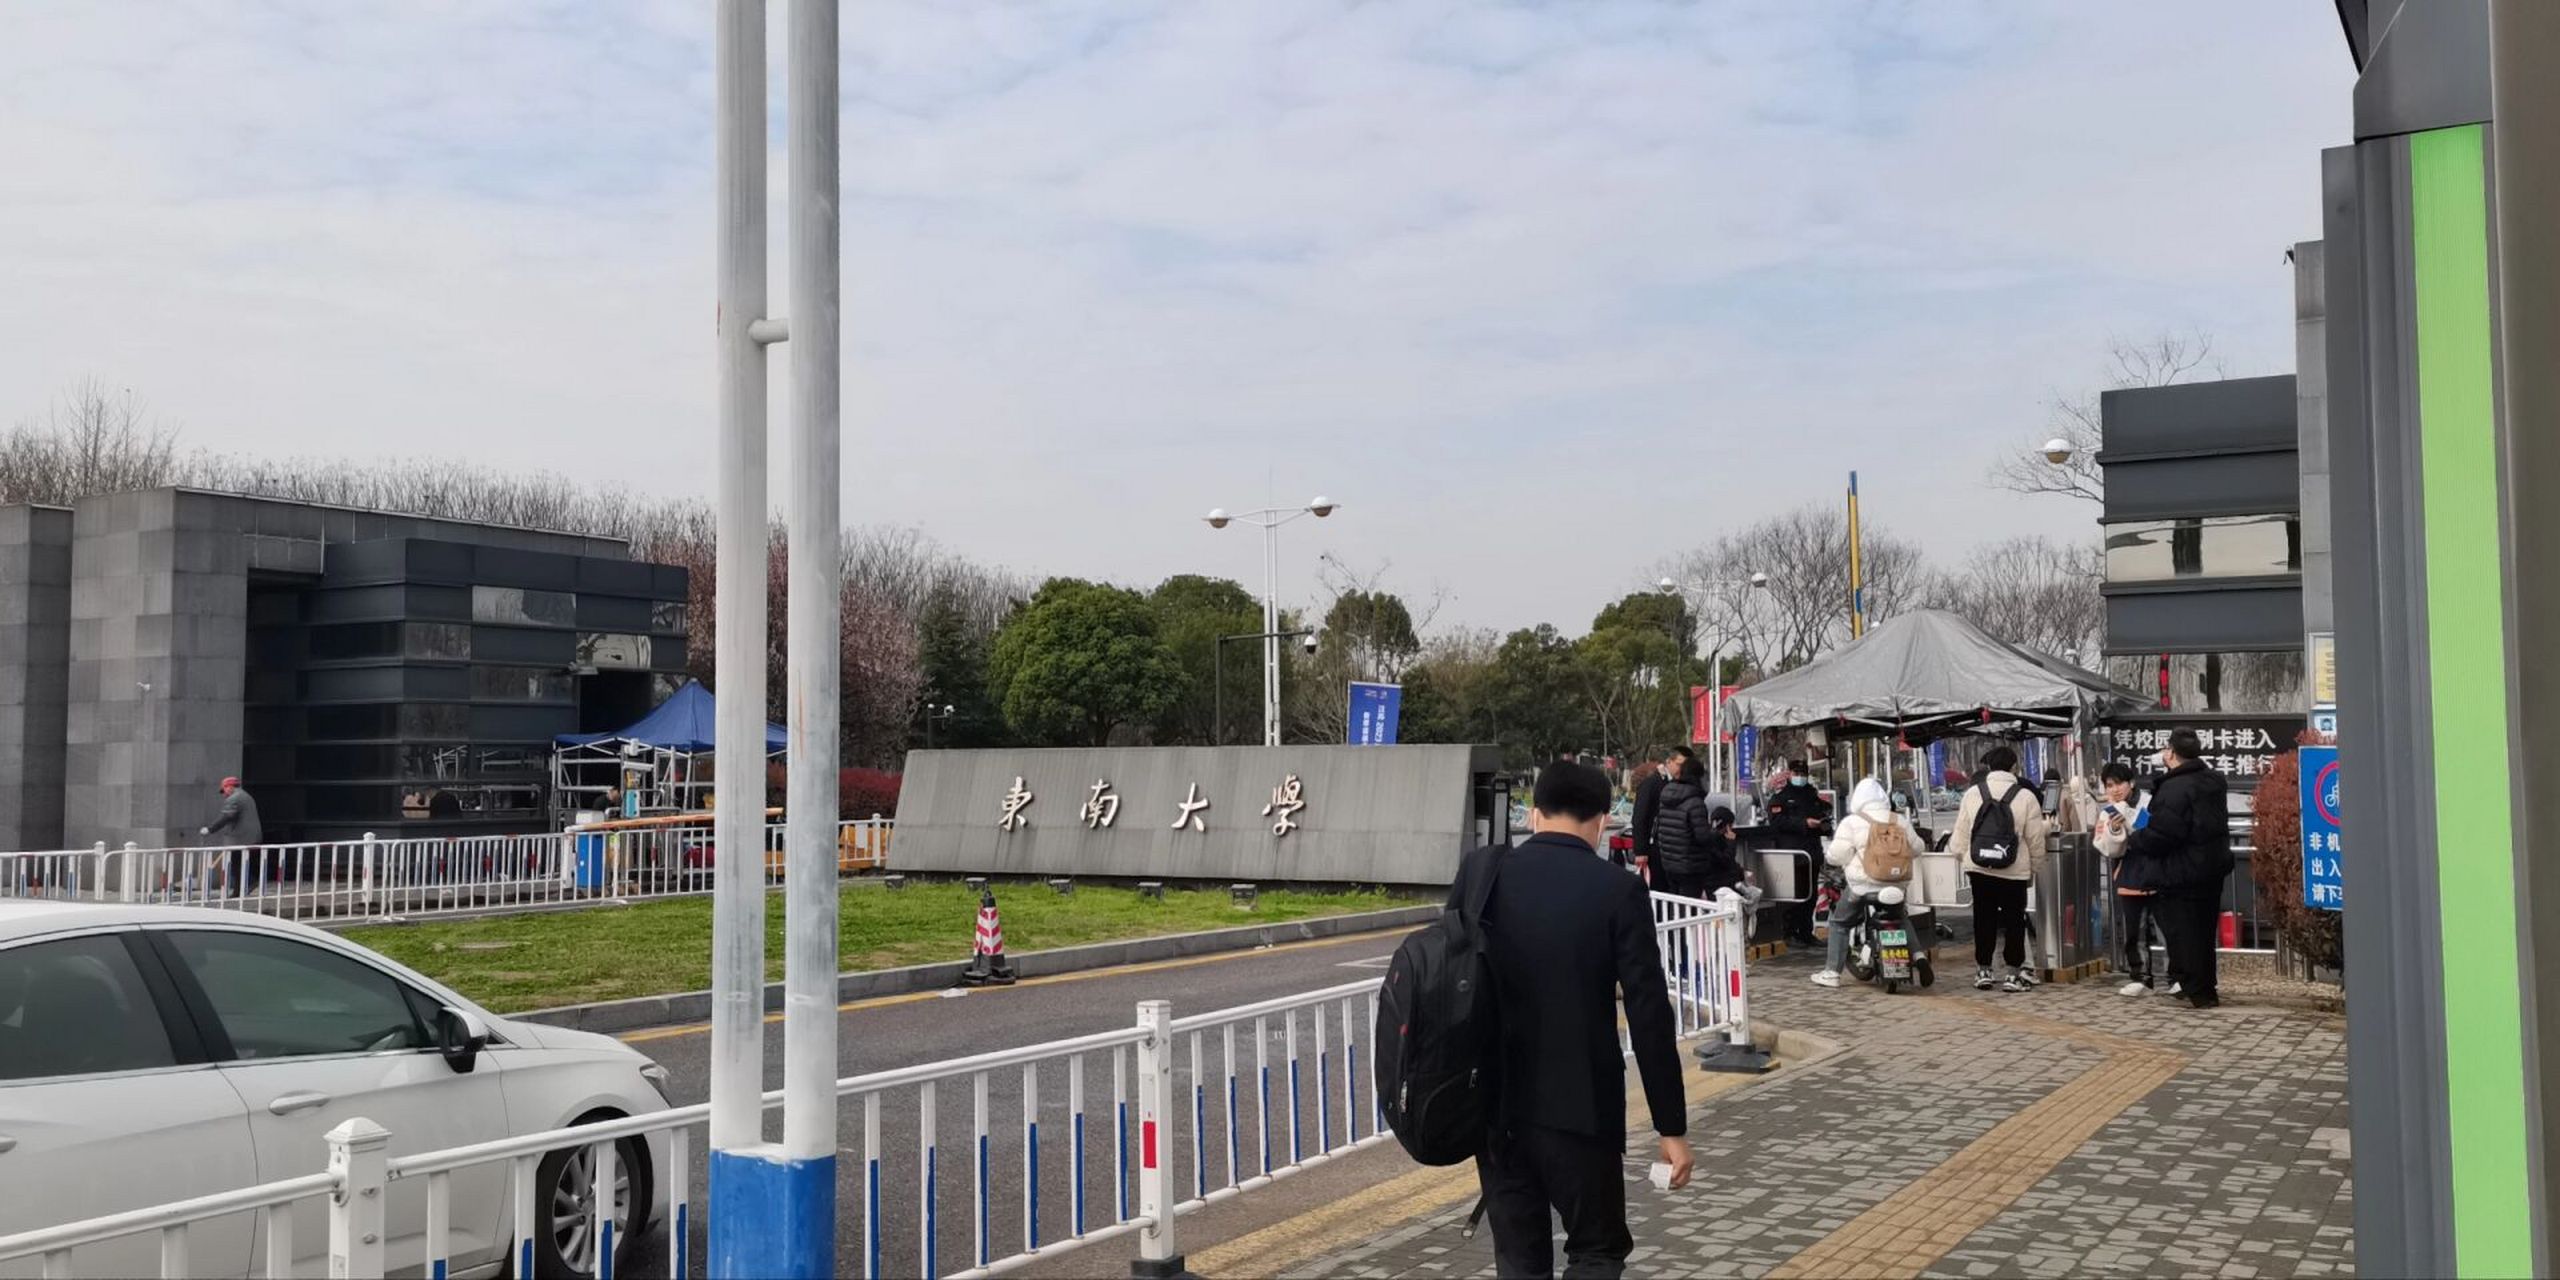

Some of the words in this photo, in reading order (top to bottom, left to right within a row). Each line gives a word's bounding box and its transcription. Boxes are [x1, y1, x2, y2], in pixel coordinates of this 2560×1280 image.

[2114, 729, 2276, 750] 凭校园刷卡进入
